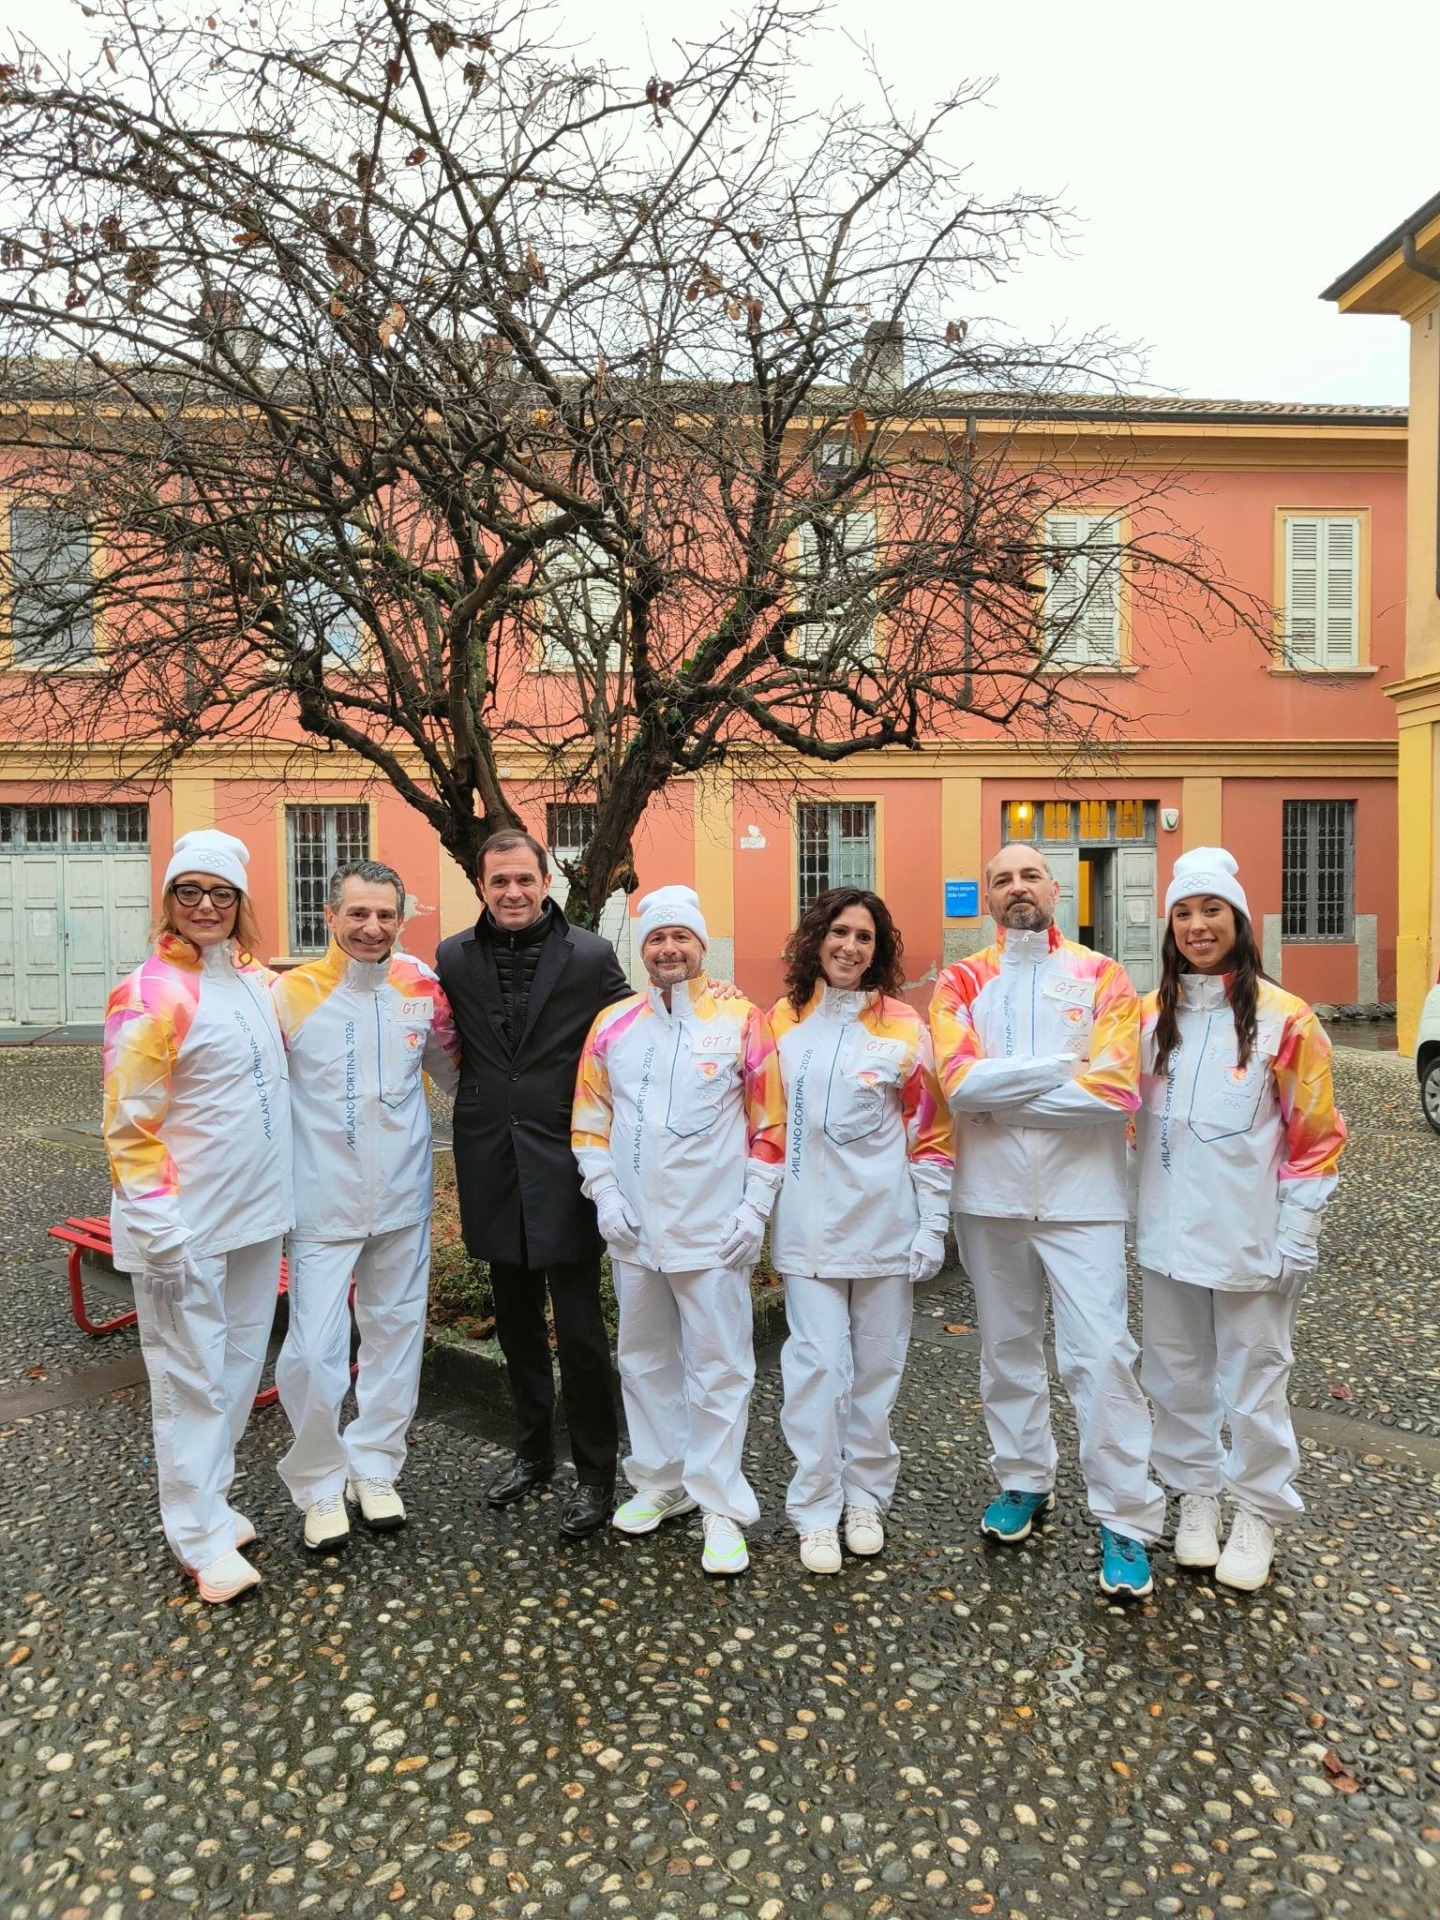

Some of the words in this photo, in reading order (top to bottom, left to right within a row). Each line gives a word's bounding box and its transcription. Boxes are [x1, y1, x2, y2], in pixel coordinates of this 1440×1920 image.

[402, 1002, 419, 1015] GT
[421, 1002, 428, 1014] 1
[1055, 982, 1077, 996] GT
[1079, 987, 1088, 998] 1
[232, 1009, 251, 1033] 2026
[345, 1021, 355, 1045] 2026
[702, 1035, 722, 1048] GT
[724, 1036, 732, 1047] 1
[1004, 1022, 1014, 1058] RTINA
[250, 1035, 265, 1088] CORTINA
[642, 1046, 655, 1069] 2026
[800, 1048, 813, 1071] 2026
[865, 1040, 888, 1052] GT
[890, 1044, 898, 1054] 1
[345, 1049, 356, 1100] CORTINA
[638, 1074, 651, 1122] CORTINA
[1163, 1067, 1175, 1120] CORTINA
[259, 1088, 272, 1141] MILANO
[794, 1074, 806, 1126] CORTINA
[346, 1101, 356, 1151] MILANO
[1160, 1122, 1171, 1175] MILANO
[633, 1125, 643, 1176] MILANO
[790, 1128, 802, 1181] MILANO
